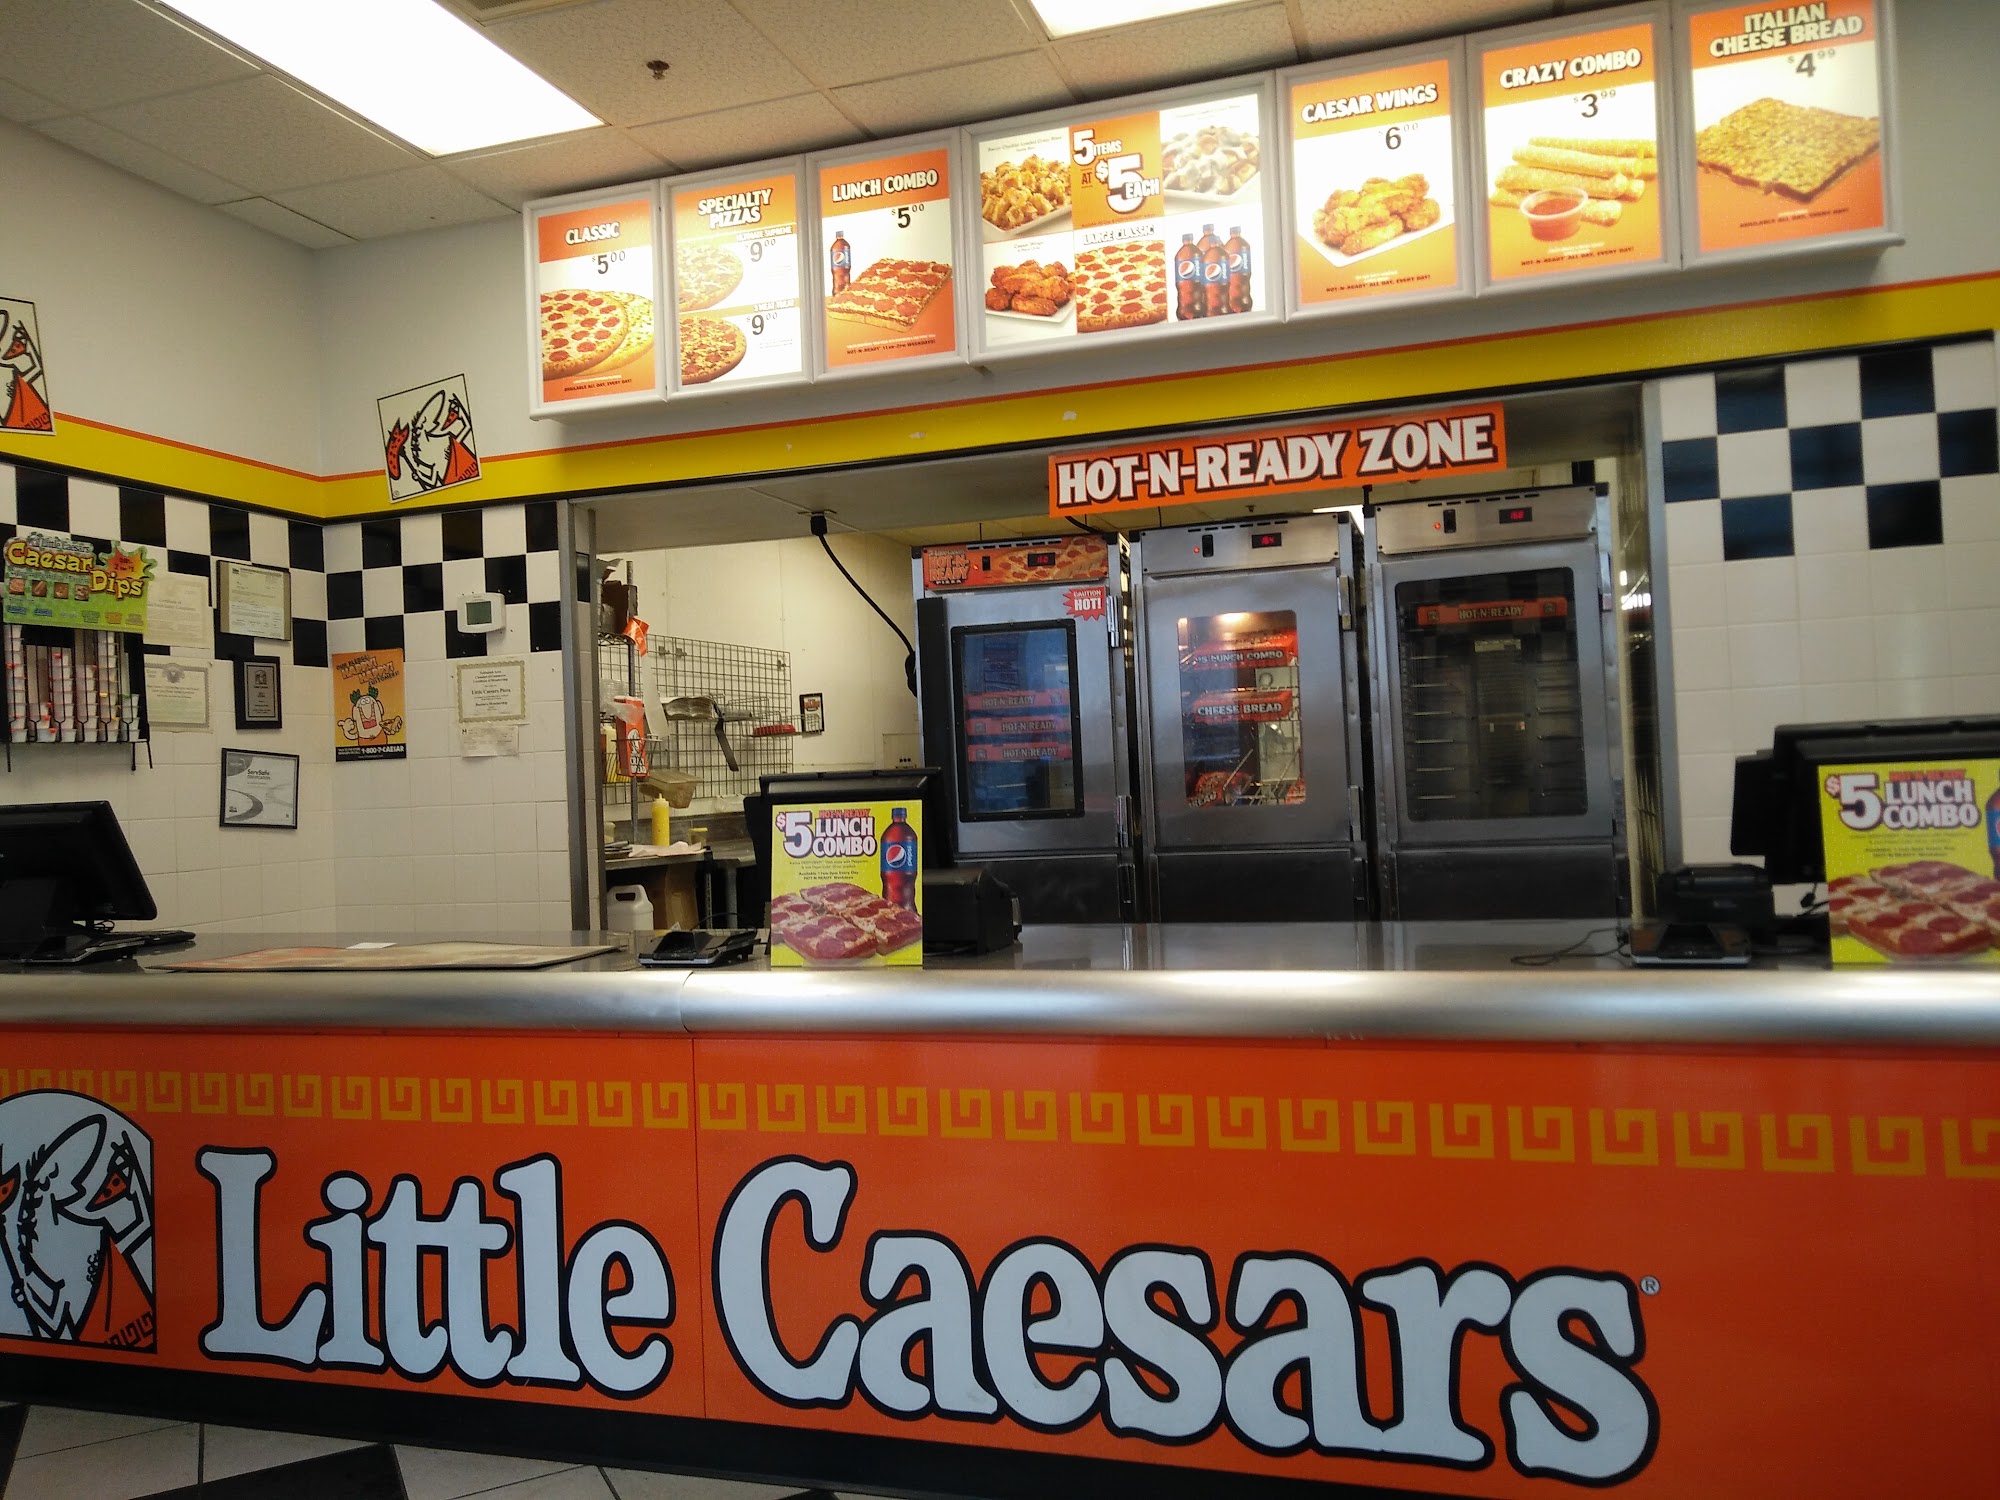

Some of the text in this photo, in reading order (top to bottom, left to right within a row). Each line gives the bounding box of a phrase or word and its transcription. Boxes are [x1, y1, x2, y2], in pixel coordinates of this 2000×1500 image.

[1744, 2, 1826, 33] ITALIAN
[1709, 16, 1863, 58] CHEESE BREAD
[1500, 47, 1642, 89] CRAZY COMBO
[1301, 83, 1439, 124] CAESAR WINGS
[1073, 128, 1122, 166] 5 ITEMS
[832, 169, 939, 203] LUNCH COMBO
[1081, 172, 1092, 184] AT
[1095, 152, 1160, 215] $5 EACH
[698, 188, 773, 216] SPECIALTY
[710, 206, 762, 230] PIZZAS
[565, 221, 621, 246] CLASSIC
[1083, 224, 1155, 246] LARGE CLASSIC
[1056, 413, 1499, 508] HOT-N-READY ZONE
[8, 541, 95, 573] Caesar
[90, 569, 145, 602] Dips
[929, 566, 969, 581] READY
[1073, 589, 1102, 598] CAUTION
[1074, 598, 1102, 612] HOT!
[1457, 605, 1525, 620] HOT-N-READY
[1211, 652, 1244, 662] LUNCH
[1246, 650, 1284, 660] COMBO
[1197, 702, 1283, 716] CHEESE BREAD
[1002, 721, 1057, 733] HOT-N-READY
[1003, 747, 1059, 759] HOT-N-READY
[818, 808, 872, 819] HOT-N-READY
[1825, 772, 1976, 830] $5 LUNCH
[1882, 803, 1981, 829] COMBO
[776, 810, 876, 859] $5 LUNCH
[812, 835, 878, 858] COMBO
[194, 1146, 1660, 1488] Little Caesars
